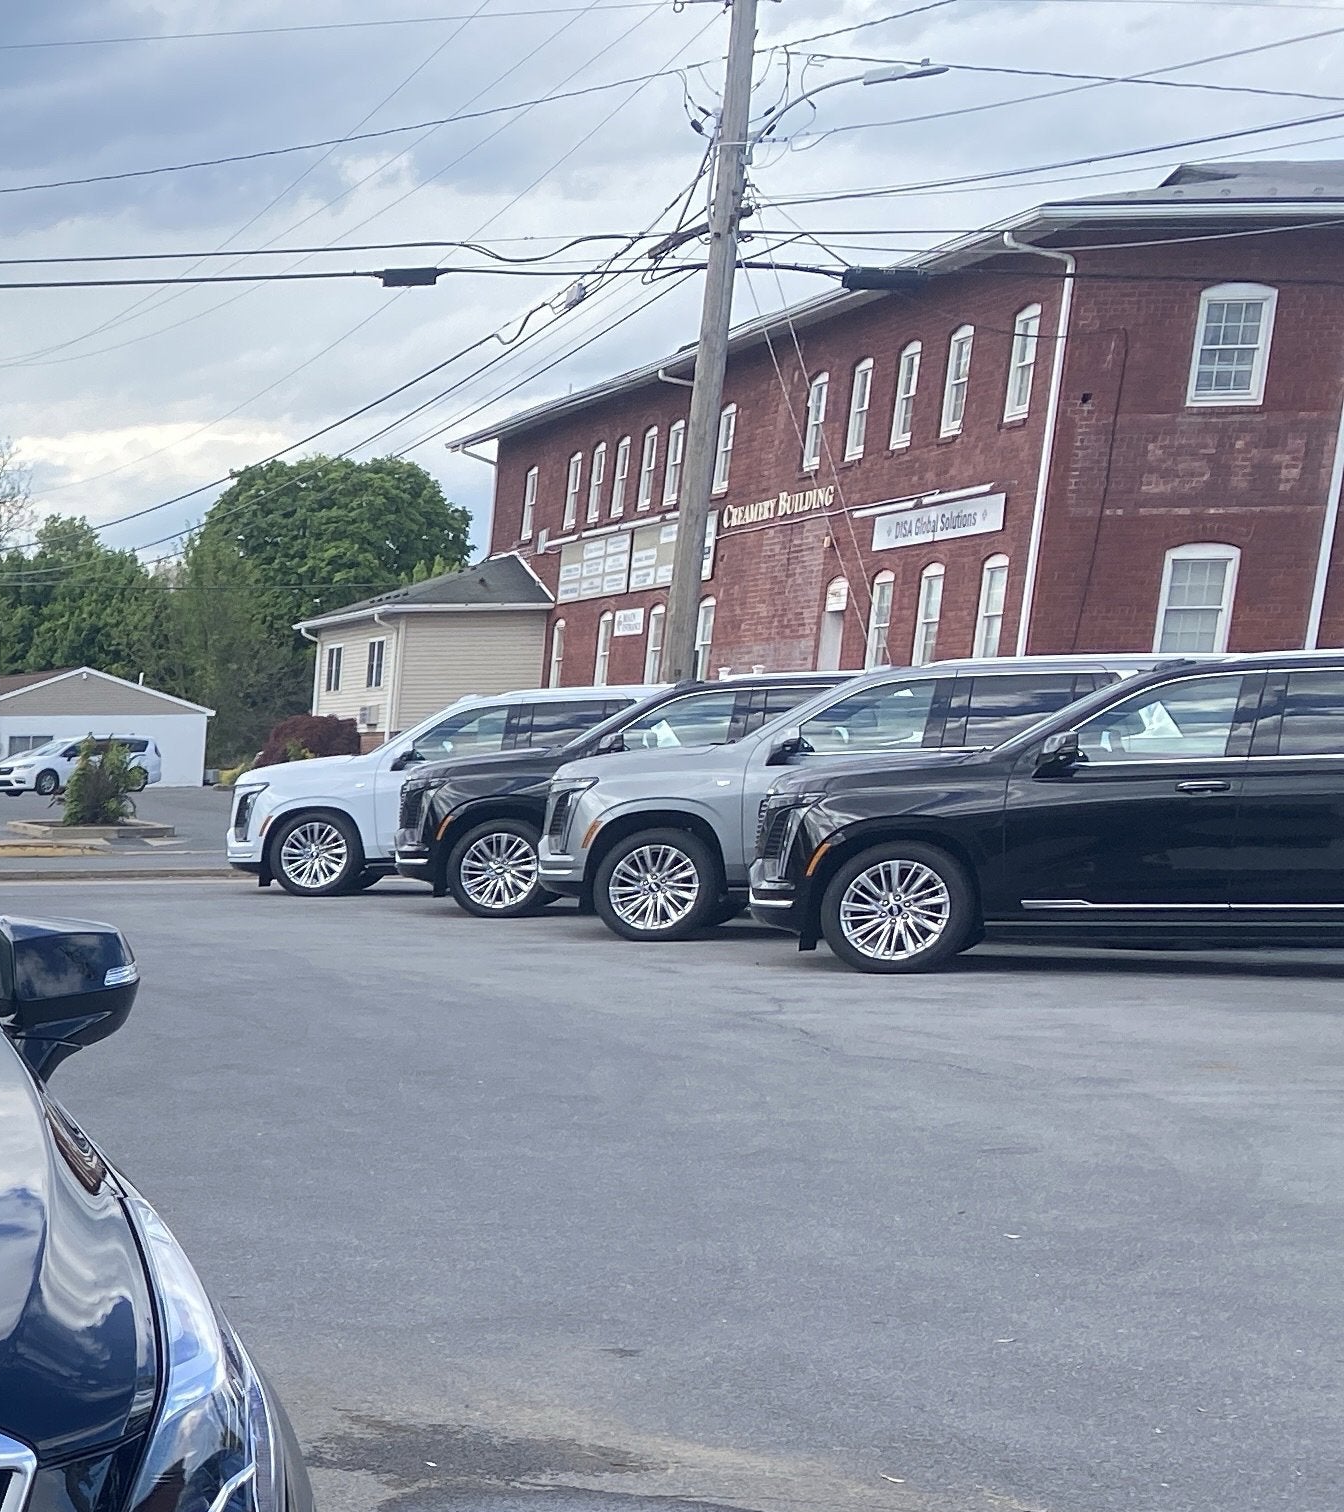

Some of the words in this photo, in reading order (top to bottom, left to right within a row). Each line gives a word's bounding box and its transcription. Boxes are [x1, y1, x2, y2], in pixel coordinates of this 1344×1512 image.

[723, 499, 778, 528] CREAMERY
[777, 485, 835, 517] BUILDING
[894, 521, 913, 539] DISA
[914, 514, 939, 536] Global
[939, 509, 978, 532] Solutions
